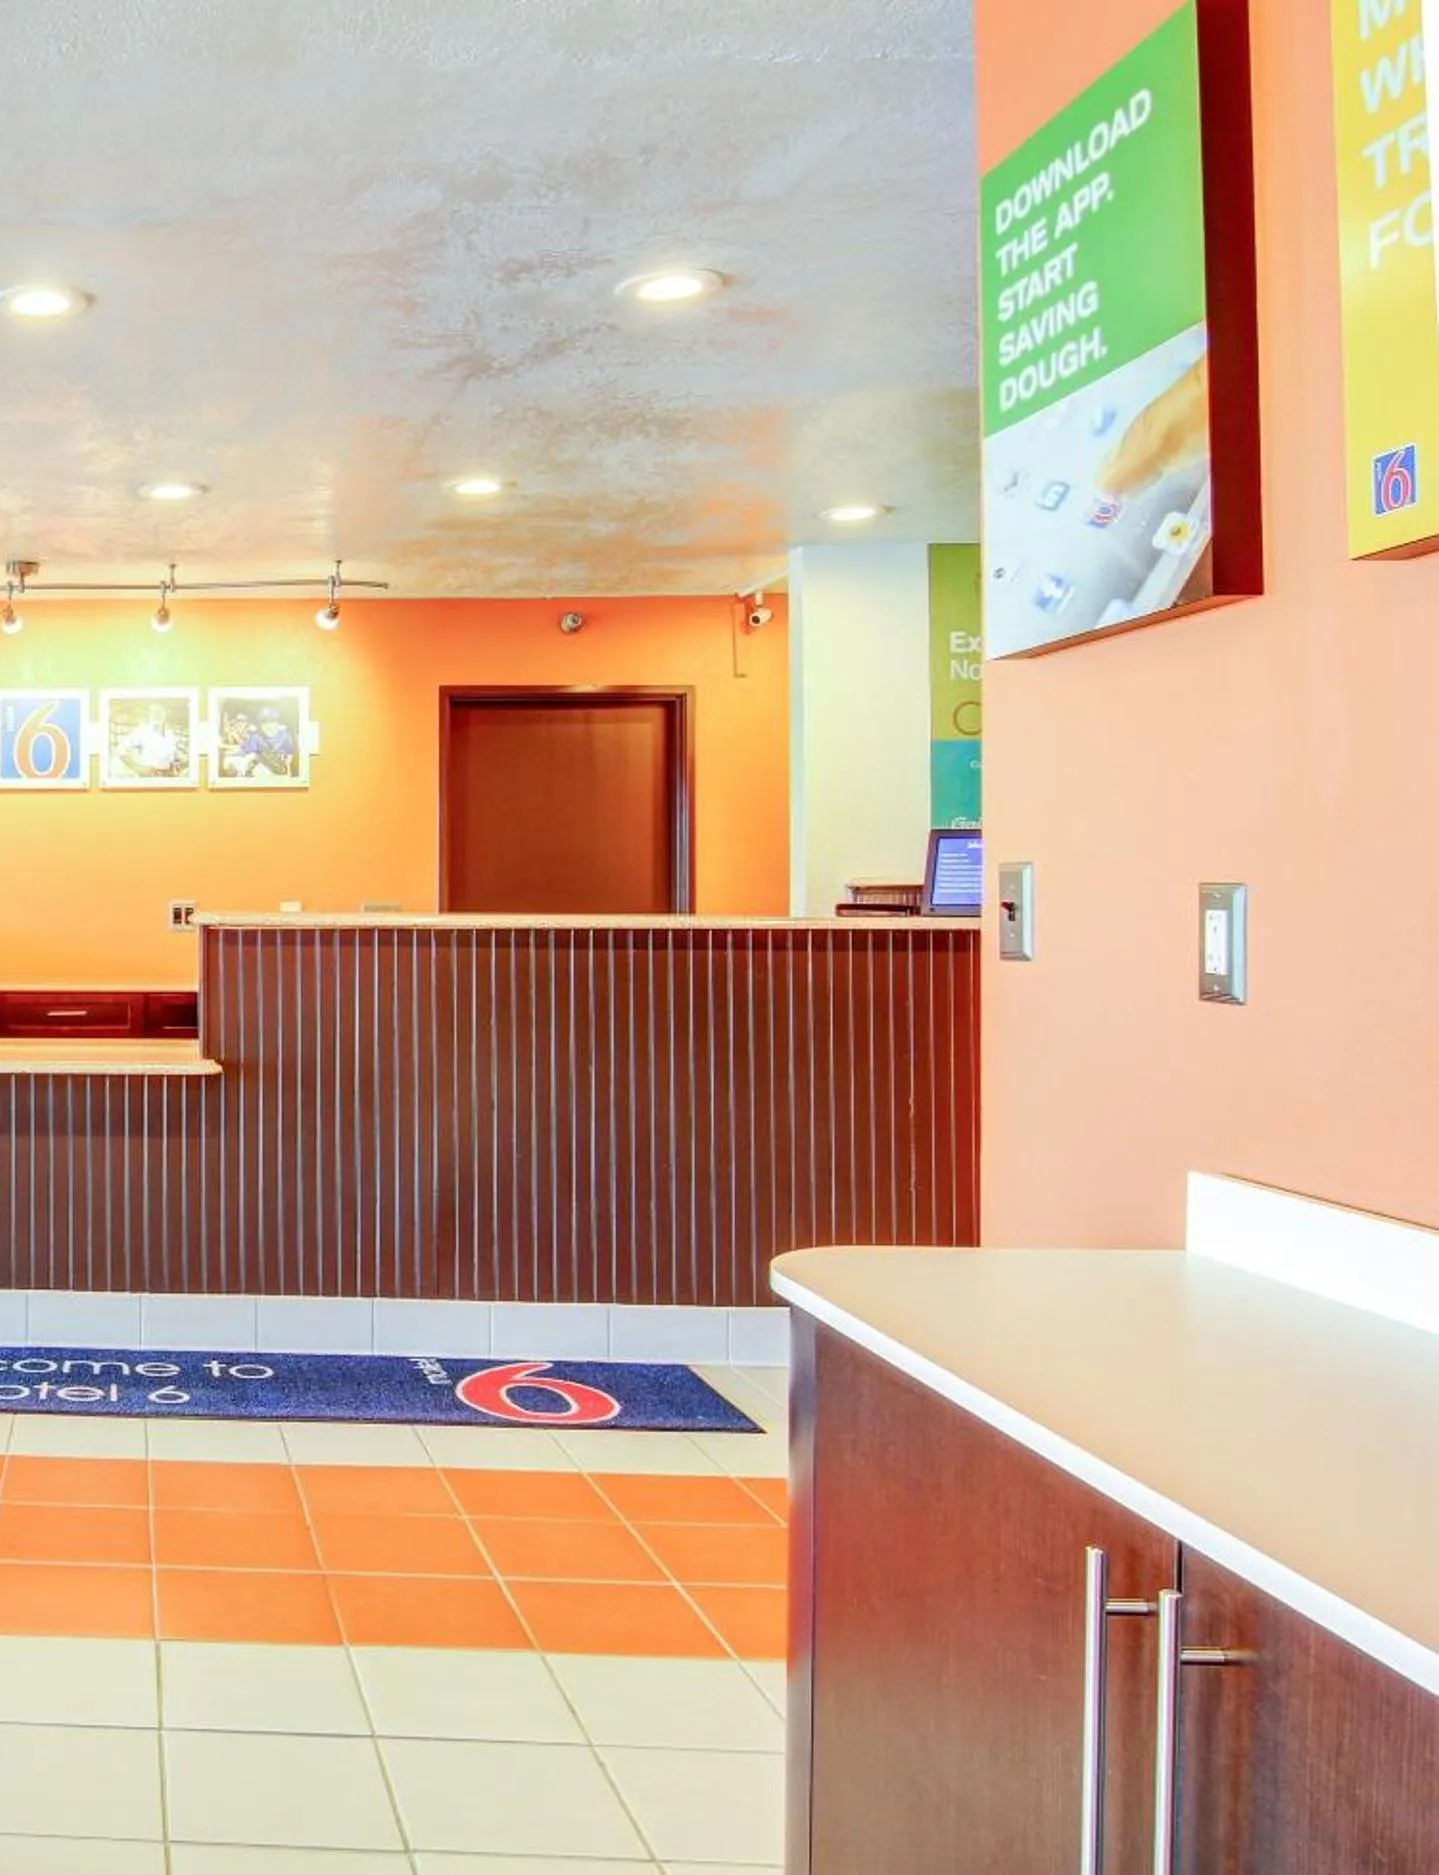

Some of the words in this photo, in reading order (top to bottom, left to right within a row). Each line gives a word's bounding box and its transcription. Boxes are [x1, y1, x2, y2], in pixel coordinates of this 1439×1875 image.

[995, 89, 1153, 236] DOWNLOAD
[995, 216, 1048, 278] THE
[1054, 171, 1115, 240] APP.
[998, 242, 1078, 322] START
[998, 280, 1100, 368] SAVING
[999, 325, 1109, 413] DOUGH.
[148, 1384, 191, 1404] 6
[202, 1359, 274, 1380] to
[456, 1362, 621, 1424] 6
